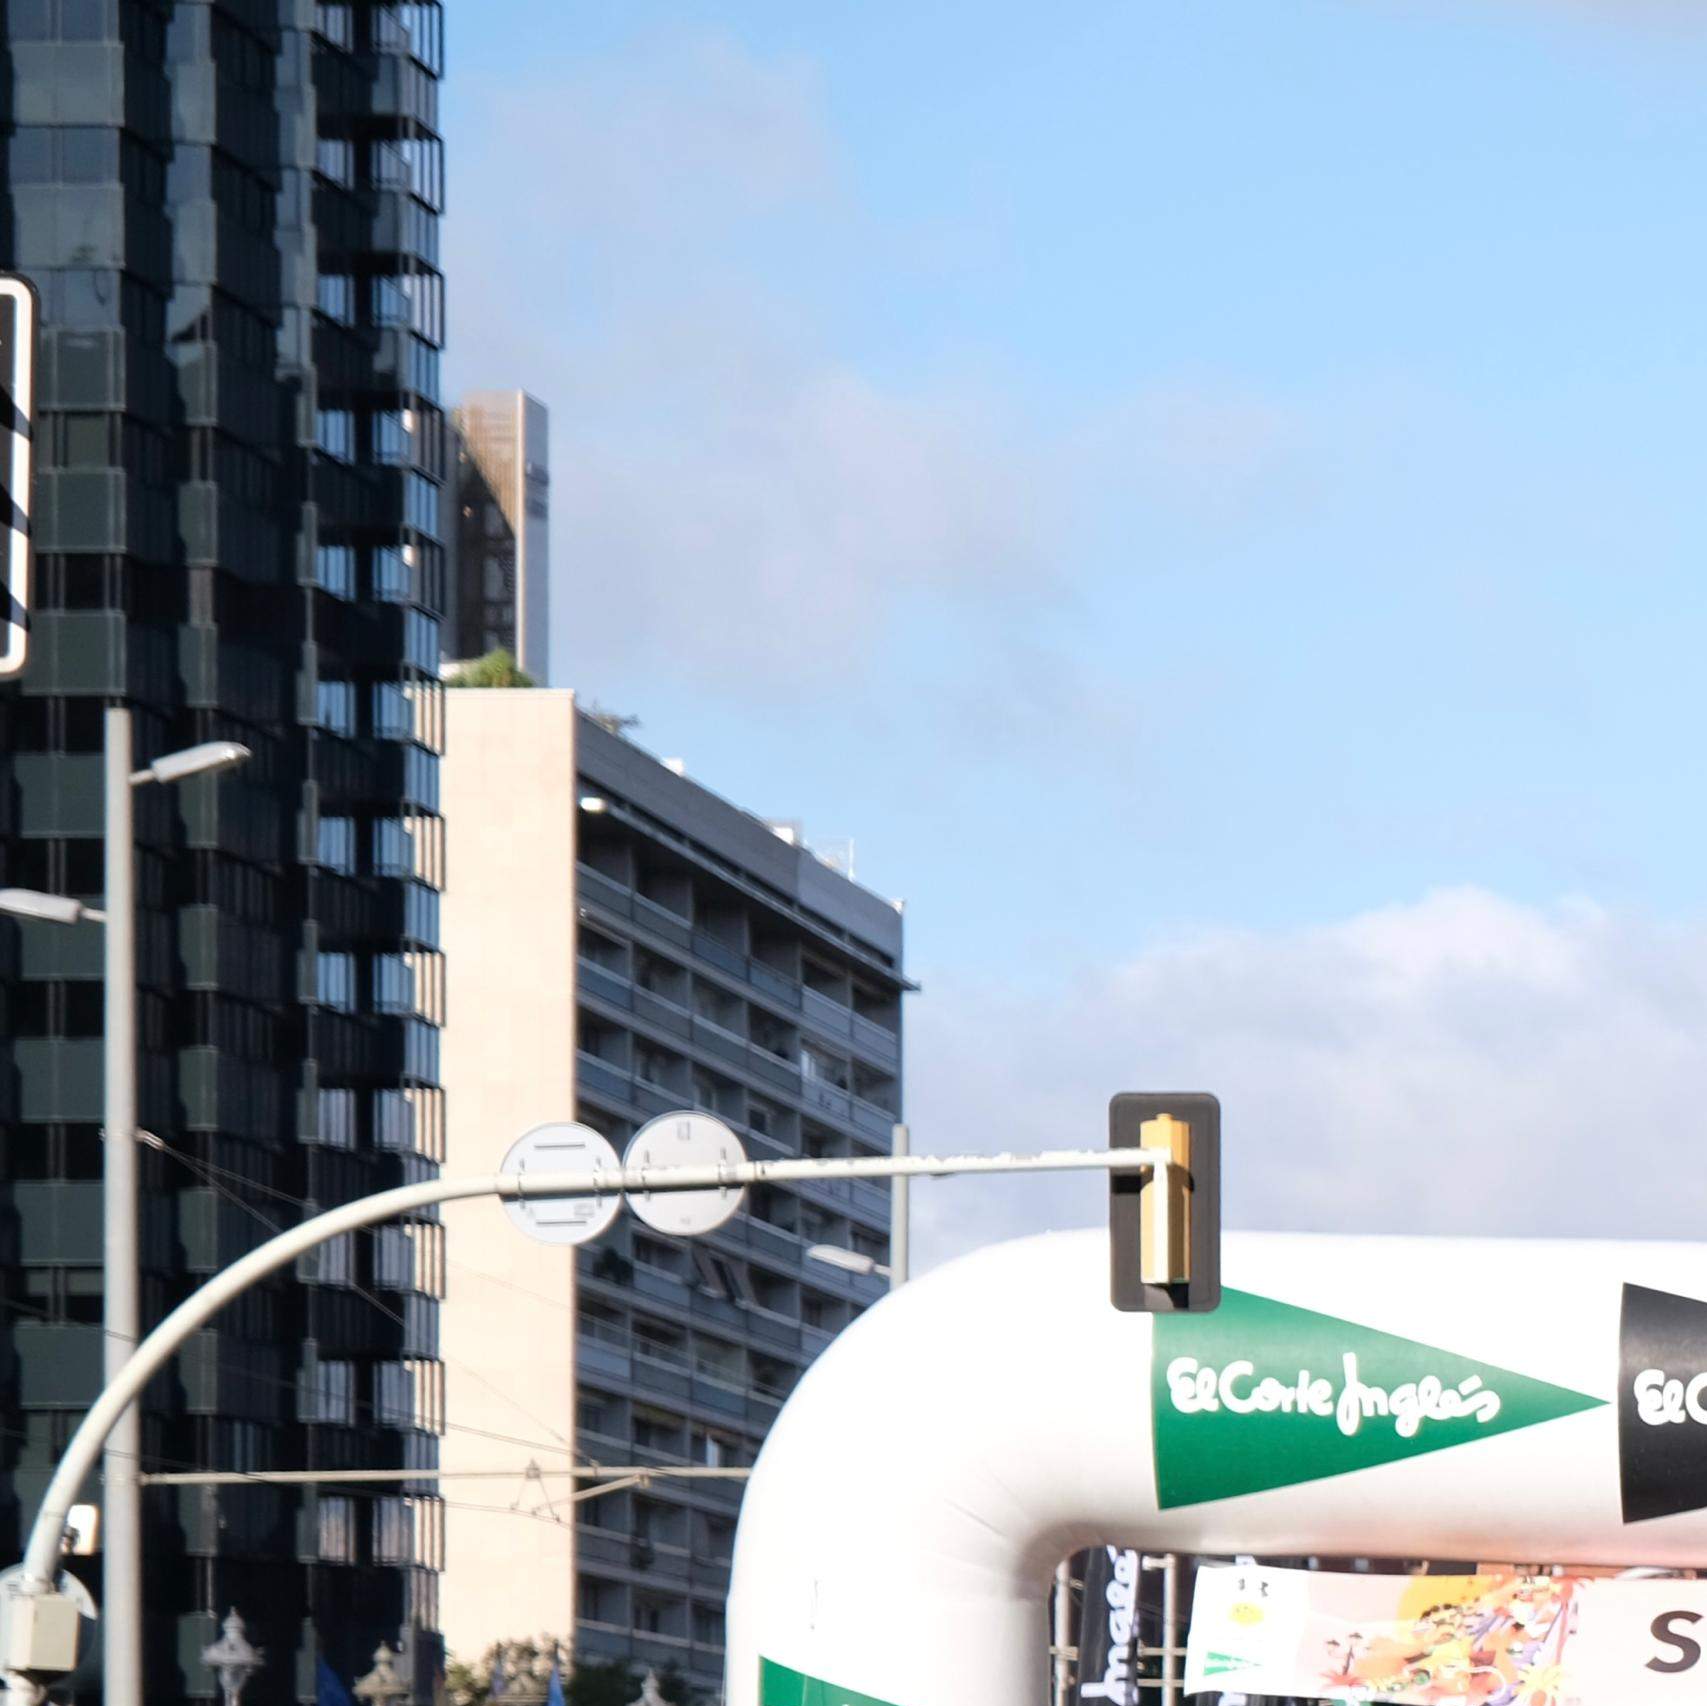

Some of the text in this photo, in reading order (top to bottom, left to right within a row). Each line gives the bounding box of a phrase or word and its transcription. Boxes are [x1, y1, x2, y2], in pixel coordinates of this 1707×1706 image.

[1167, 1353, 1502, 1437] El Corte Inglés
[1634, 1368, 1686, 1426] El
